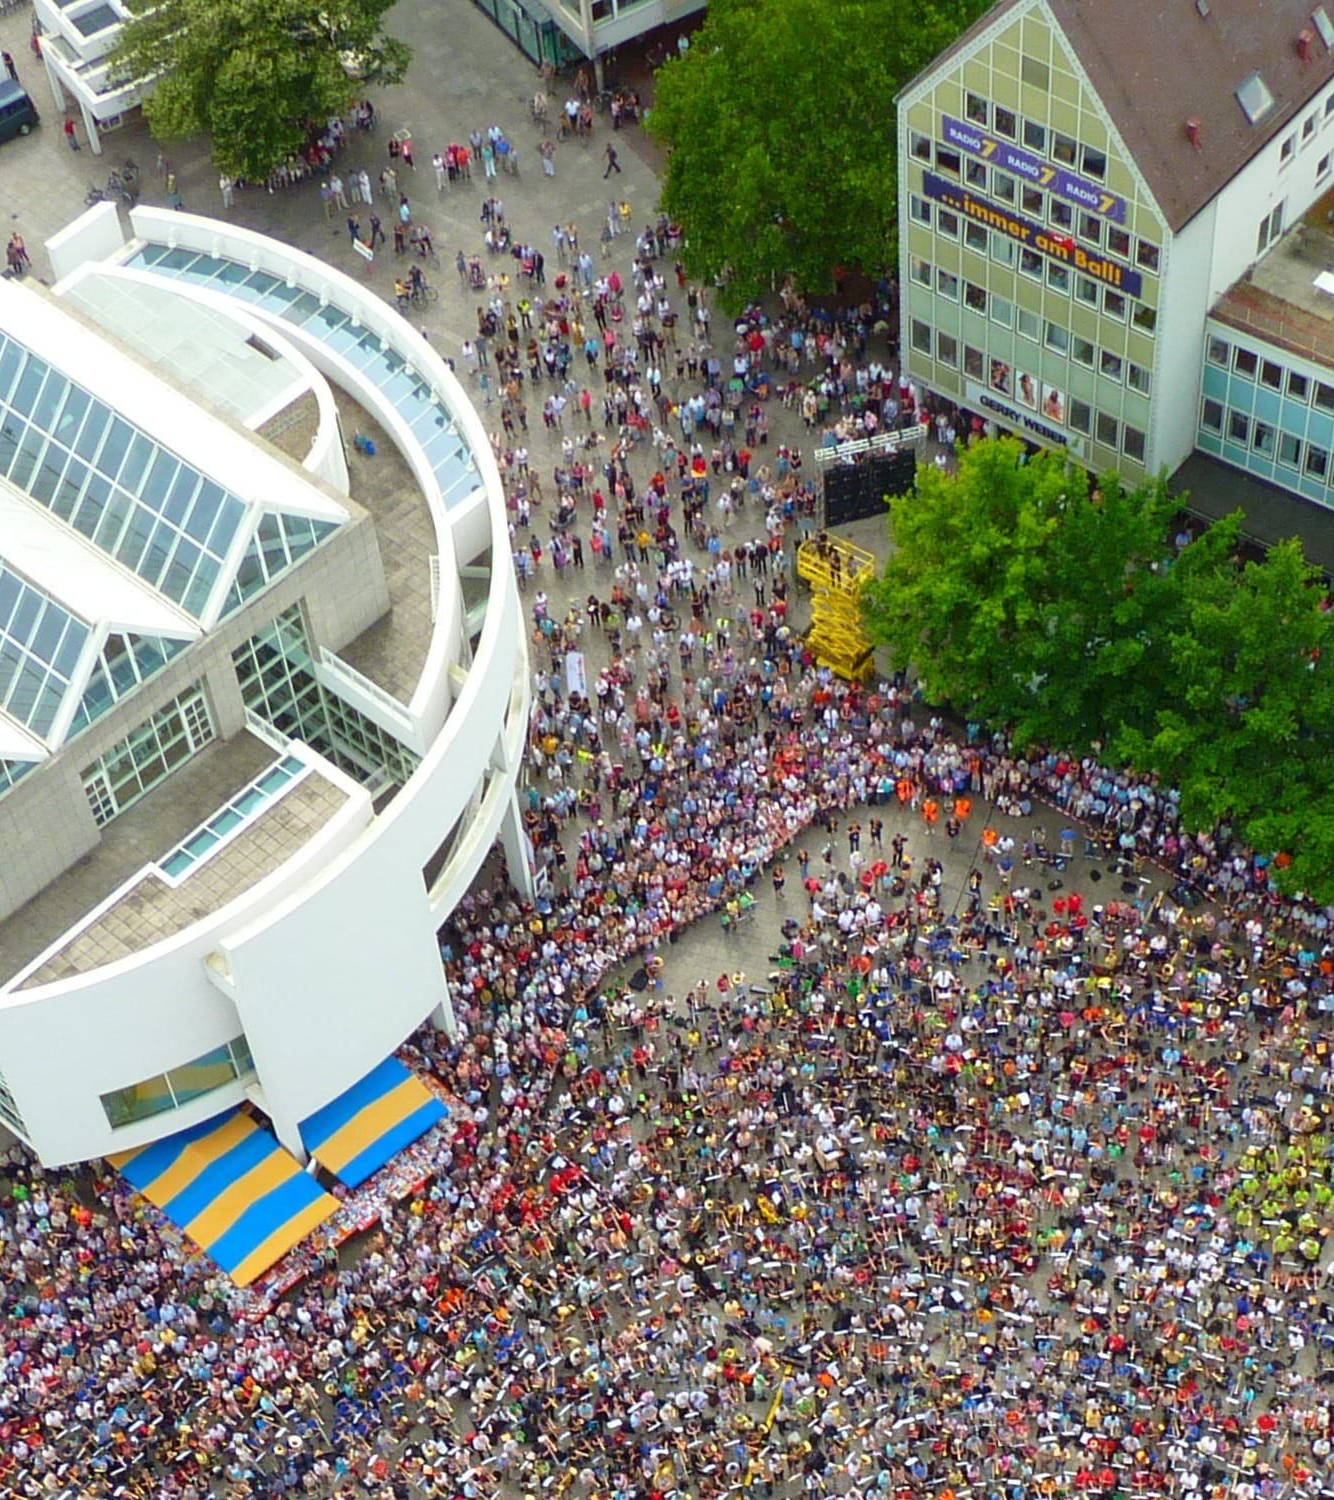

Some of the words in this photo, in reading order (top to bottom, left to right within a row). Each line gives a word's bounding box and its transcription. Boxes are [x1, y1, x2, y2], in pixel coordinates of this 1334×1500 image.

[949, 128, 980, 150] RADIO
[981, 135, 998, 159] 7
[1007, 156, 1039, 177] RADIO
[1039, 164, 1056, 186] 7
[1066, 183, 1098, 206] RADIO
[1098, 194, 1116, 214] 7
[963, 194, 1031, 240] immer
[1034, 231, 1068, 259] am
[1074, 245, 1122, 285] Ball!
[980, 395, 1021, 422] GERRY
[1023, 415, 1067, 445] WEBER
